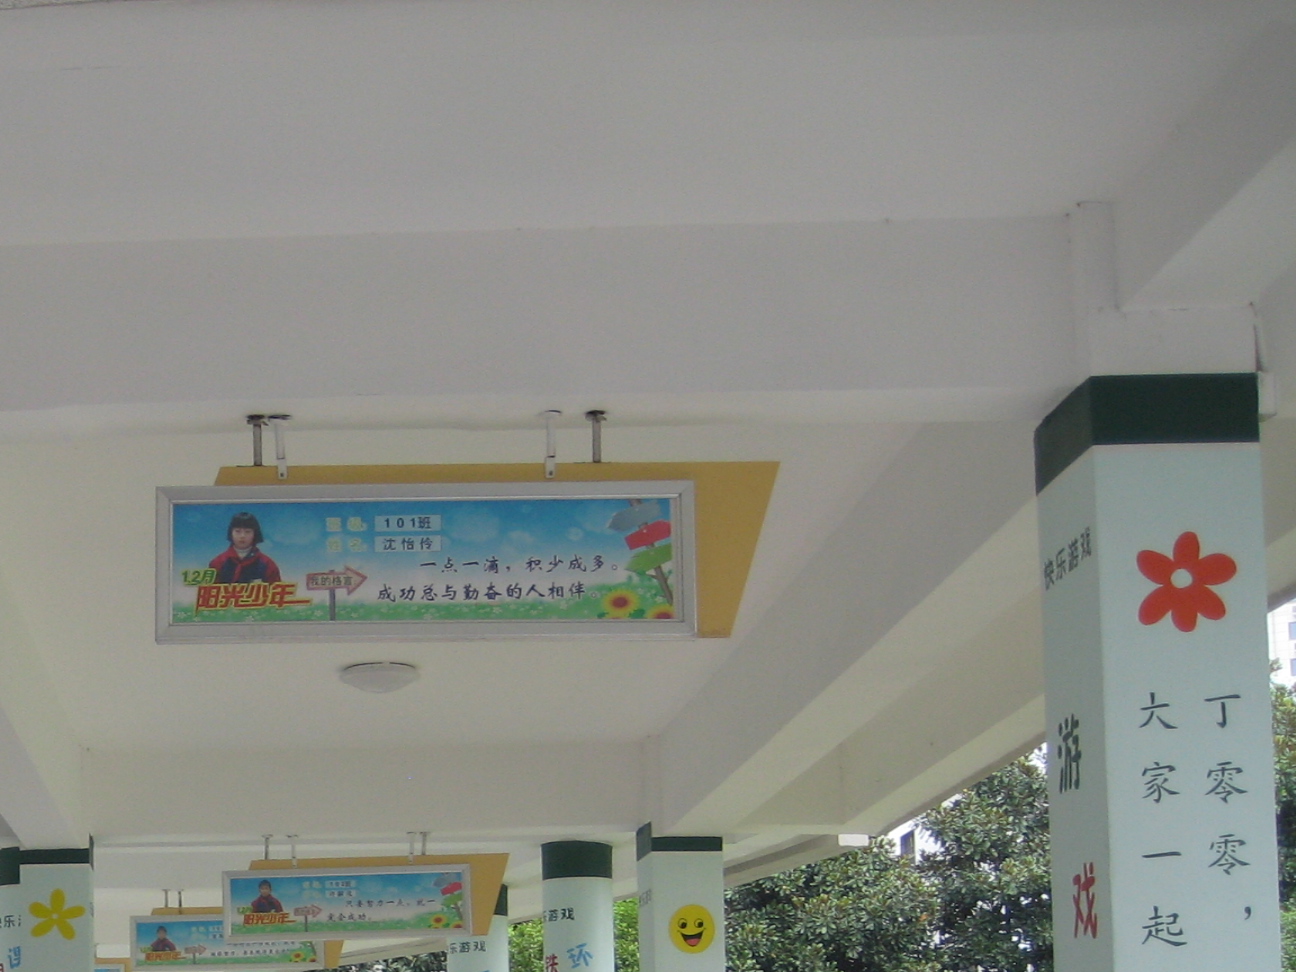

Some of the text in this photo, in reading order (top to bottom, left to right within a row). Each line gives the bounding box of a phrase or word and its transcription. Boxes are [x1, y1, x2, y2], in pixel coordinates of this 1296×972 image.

[1042, 527, 1093, 590] 快乐游戏
[194, 582, 312, 615] 阳光少年
